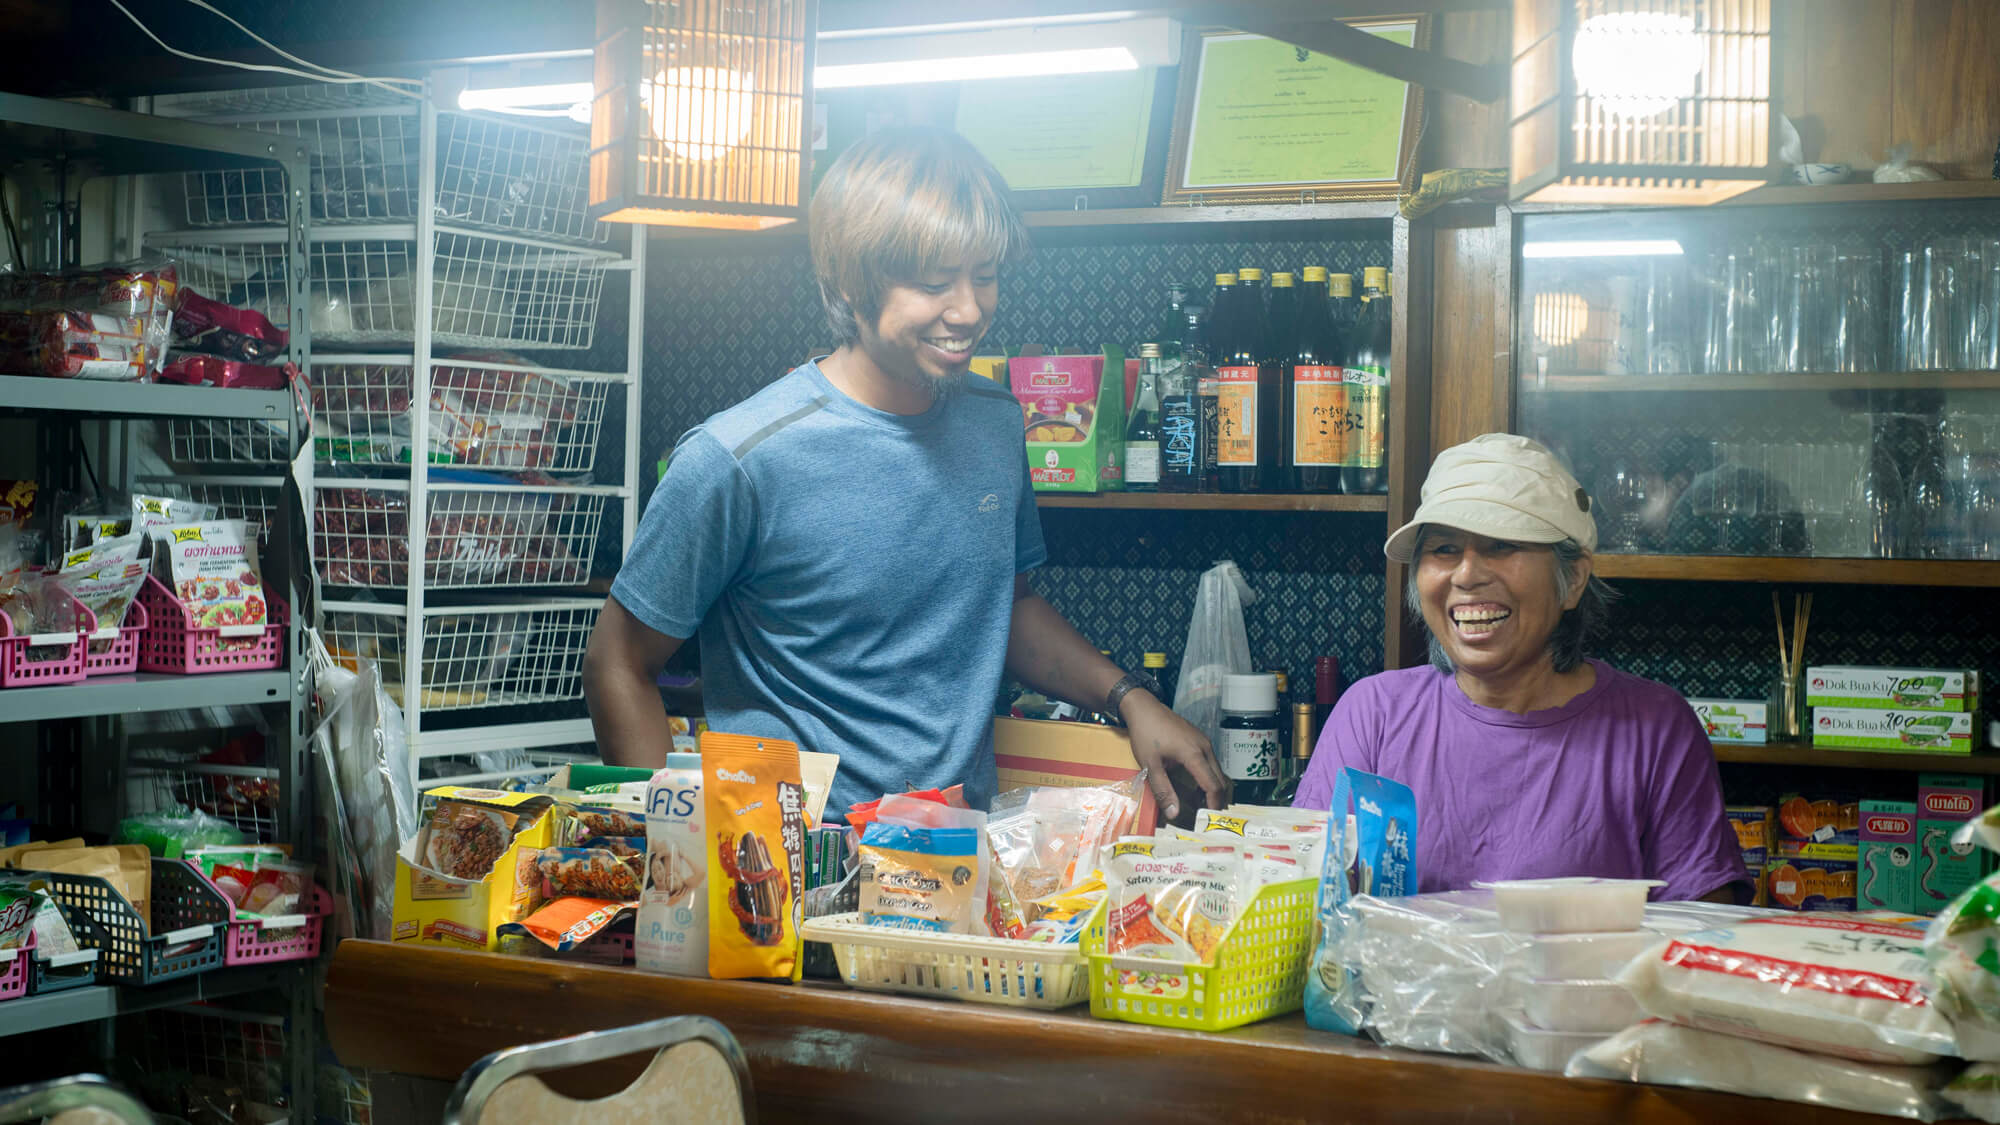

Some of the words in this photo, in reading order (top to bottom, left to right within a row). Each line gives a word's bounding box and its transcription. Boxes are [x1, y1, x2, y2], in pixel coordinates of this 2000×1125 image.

[1033, 471, 1049, 481] MAE
[1825, 679, 1847, 690] Dok
[1850, 680, 1870, 691] Bua
[1887, 676, 1924, 697] 700
[1832, 719, 1854, 729] Dok
[1857, 720, 1877, 730] Bua
[716, 768, 756, 784] ChaCha
[1125, 876, 1153, 887] Satay
[1156, 875, 1206, 890] Seaoning
[1209, 882, 1226, 891] Mix
[651, 922, 686, 943] Pure
